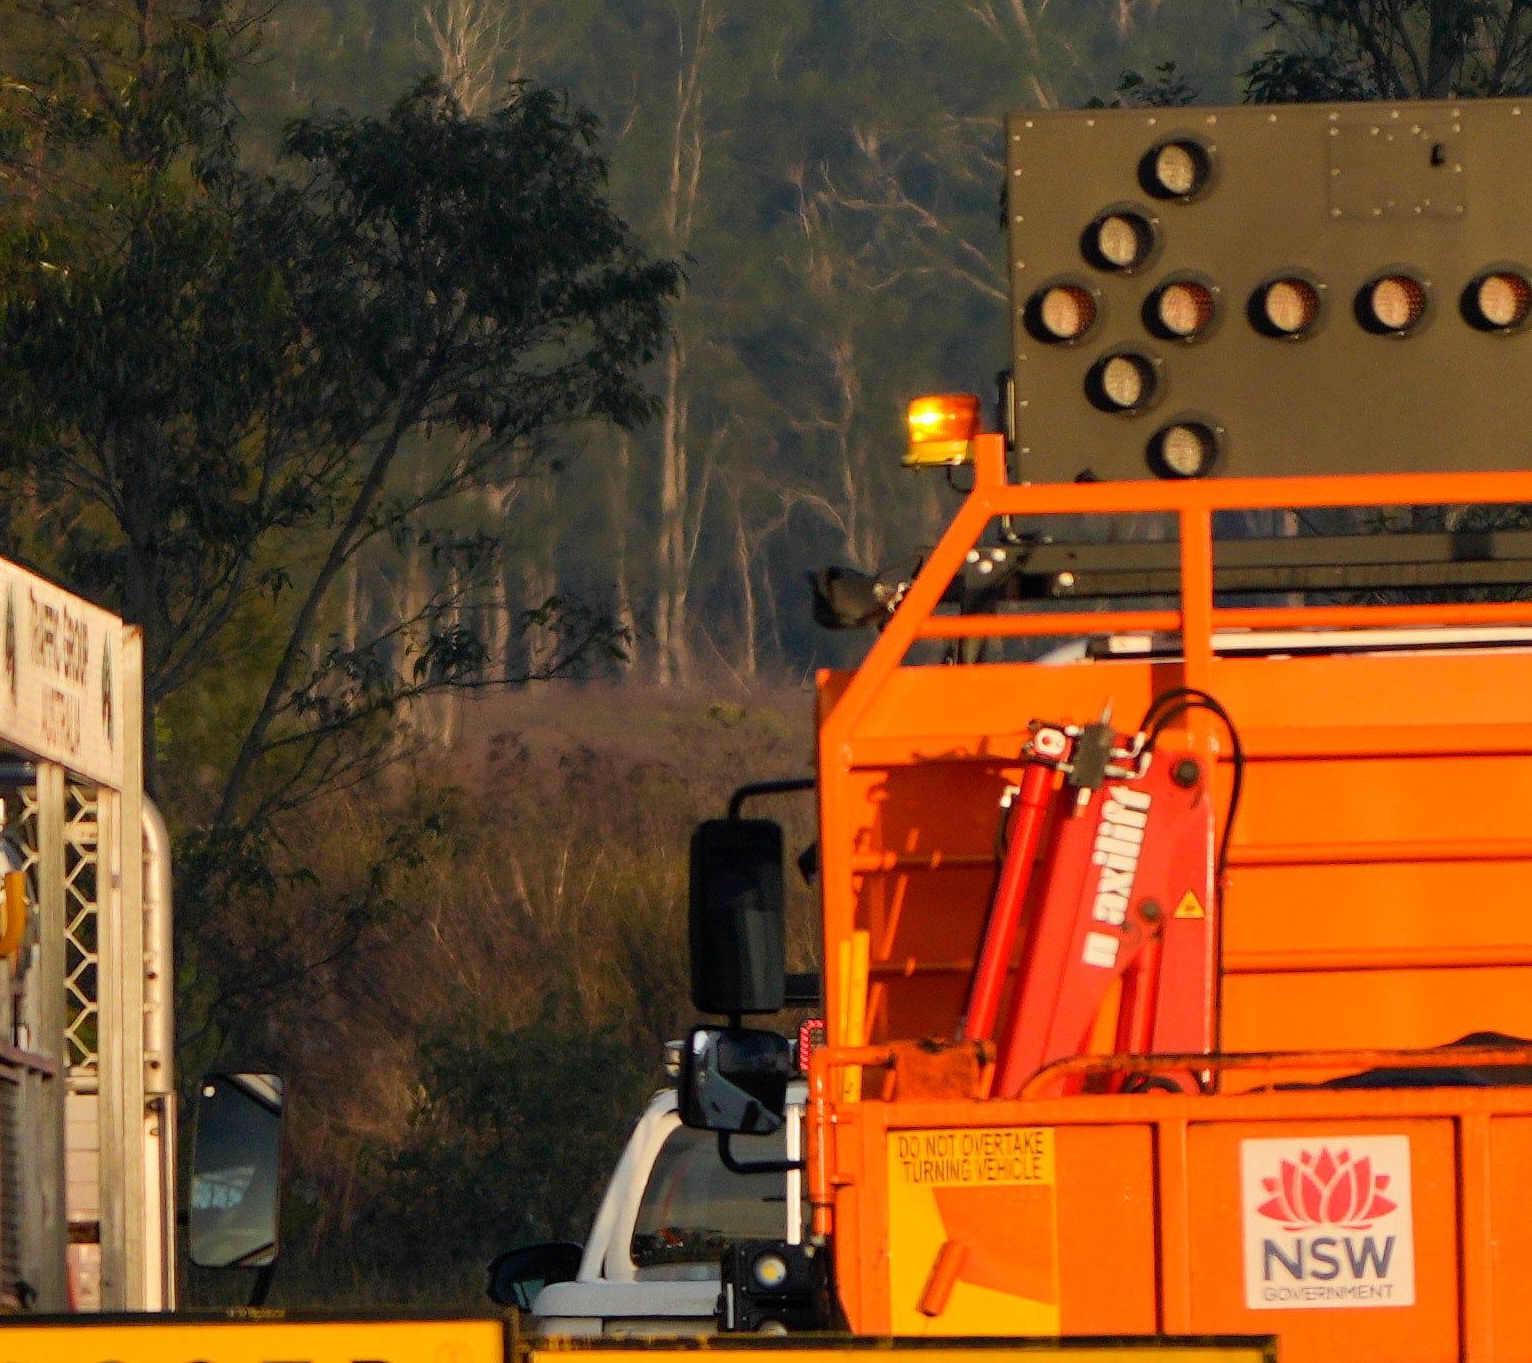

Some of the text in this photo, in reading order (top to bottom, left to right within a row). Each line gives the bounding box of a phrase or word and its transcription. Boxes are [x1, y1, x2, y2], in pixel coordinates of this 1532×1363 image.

[898, 1131, 1045, 1158] DO NOT OVERTAKE
[903, 1156, 1045, 1183] TURNING VEHICLE
[1263, 1236, 1396, 1281] NSW
[1263, 1284, 1394, 1302] GOVERNMENT
